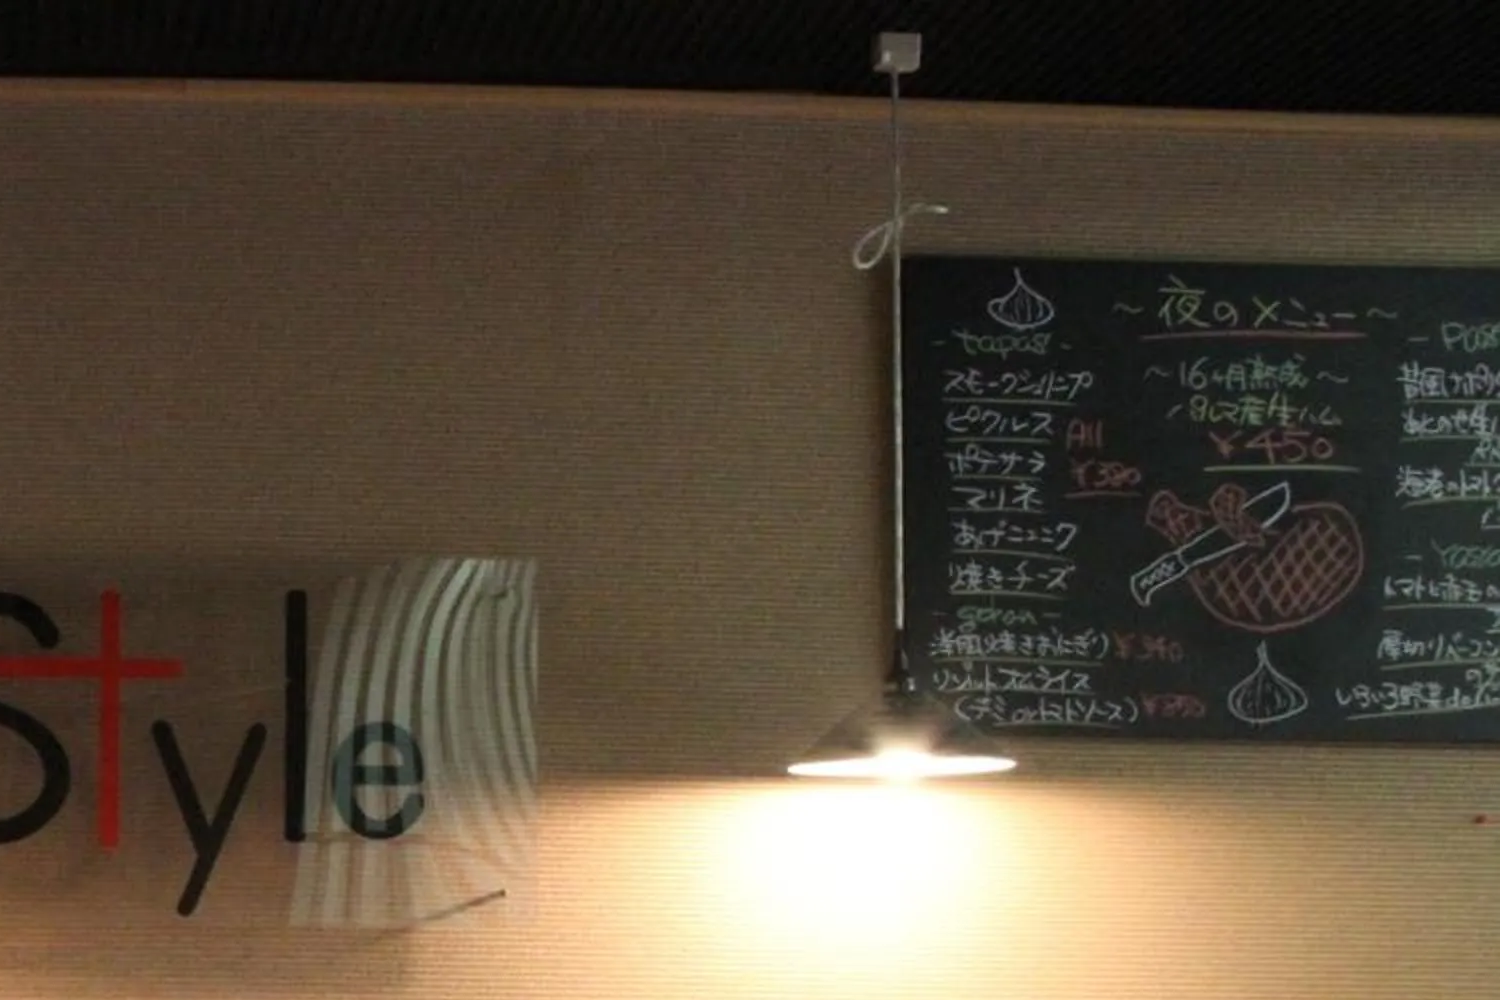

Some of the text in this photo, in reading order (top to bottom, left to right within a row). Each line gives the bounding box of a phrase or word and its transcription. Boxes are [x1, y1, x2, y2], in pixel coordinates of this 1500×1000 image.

[945, 405, 1054, 436] ピクルス
[943, 444, 1046, 476] ポテサラ
[952, 483, 1044, 510] マリネ
[949, 560, 1076, 591] 焼きチーズ
